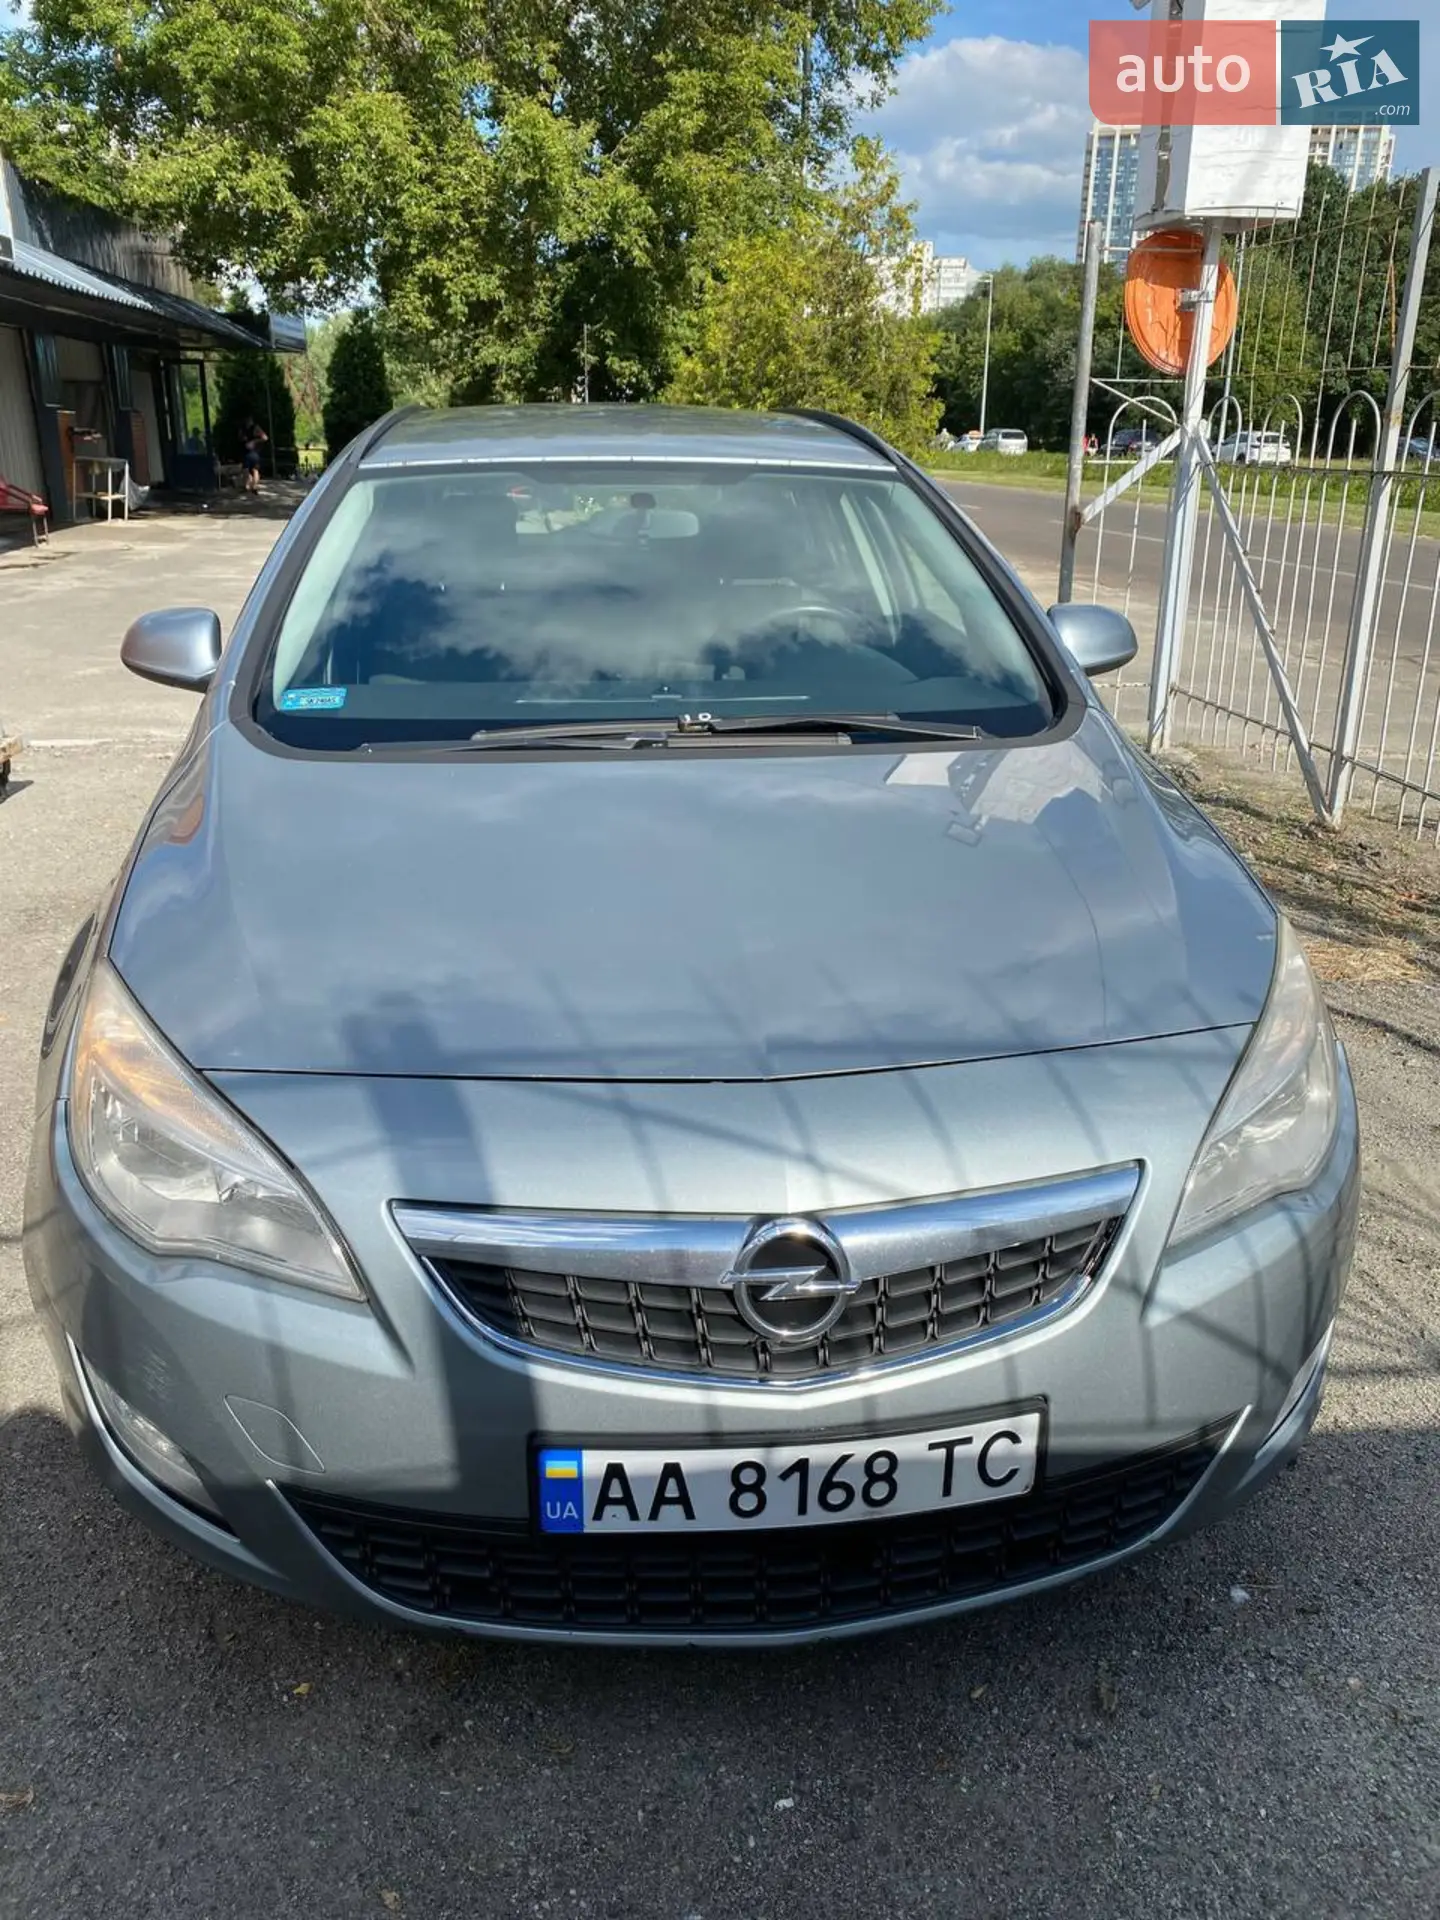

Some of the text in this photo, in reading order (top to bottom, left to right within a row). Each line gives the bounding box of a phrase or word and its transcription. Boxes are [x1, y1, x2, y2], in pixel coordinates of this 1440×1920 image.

[592, 1430, 1023, 1522] AA 8168 TC
[546, 1501, 579, 1519] UA
